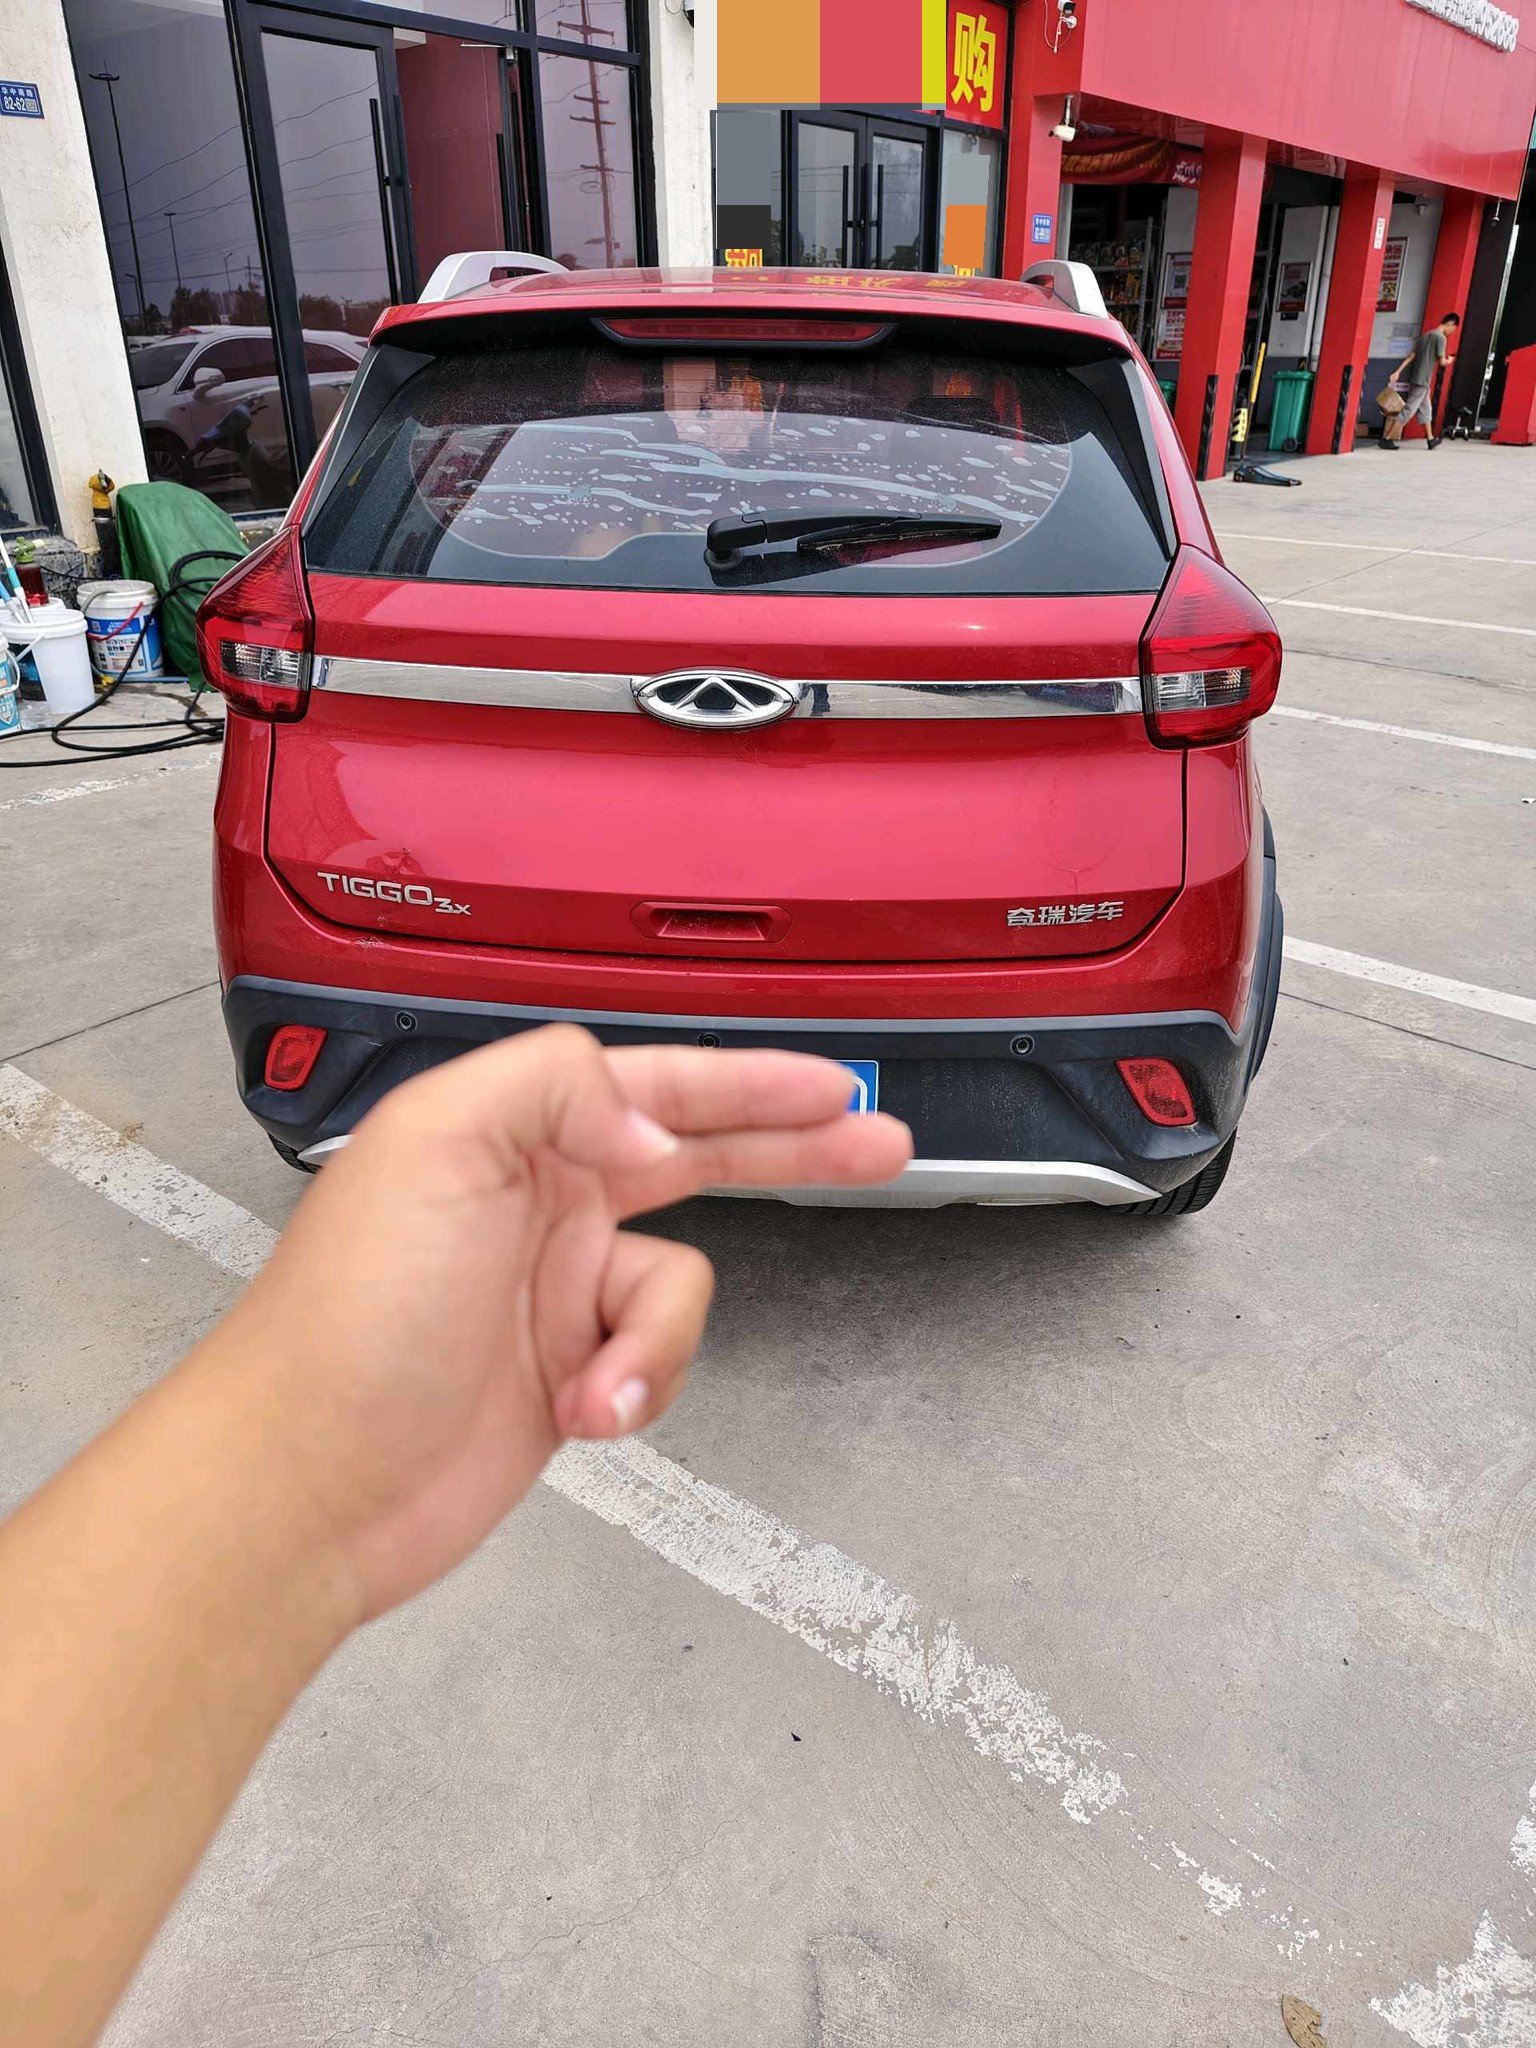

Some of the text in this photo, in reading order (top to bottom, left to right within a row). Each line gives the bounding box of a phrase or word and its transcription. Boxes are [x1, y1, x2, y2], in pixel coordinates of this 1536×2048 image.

[951, 11, 996, 113] 购
[4, 96, 26, 111] 82-62
[1007, 901, 1124, 926] 奇瑞汽车
